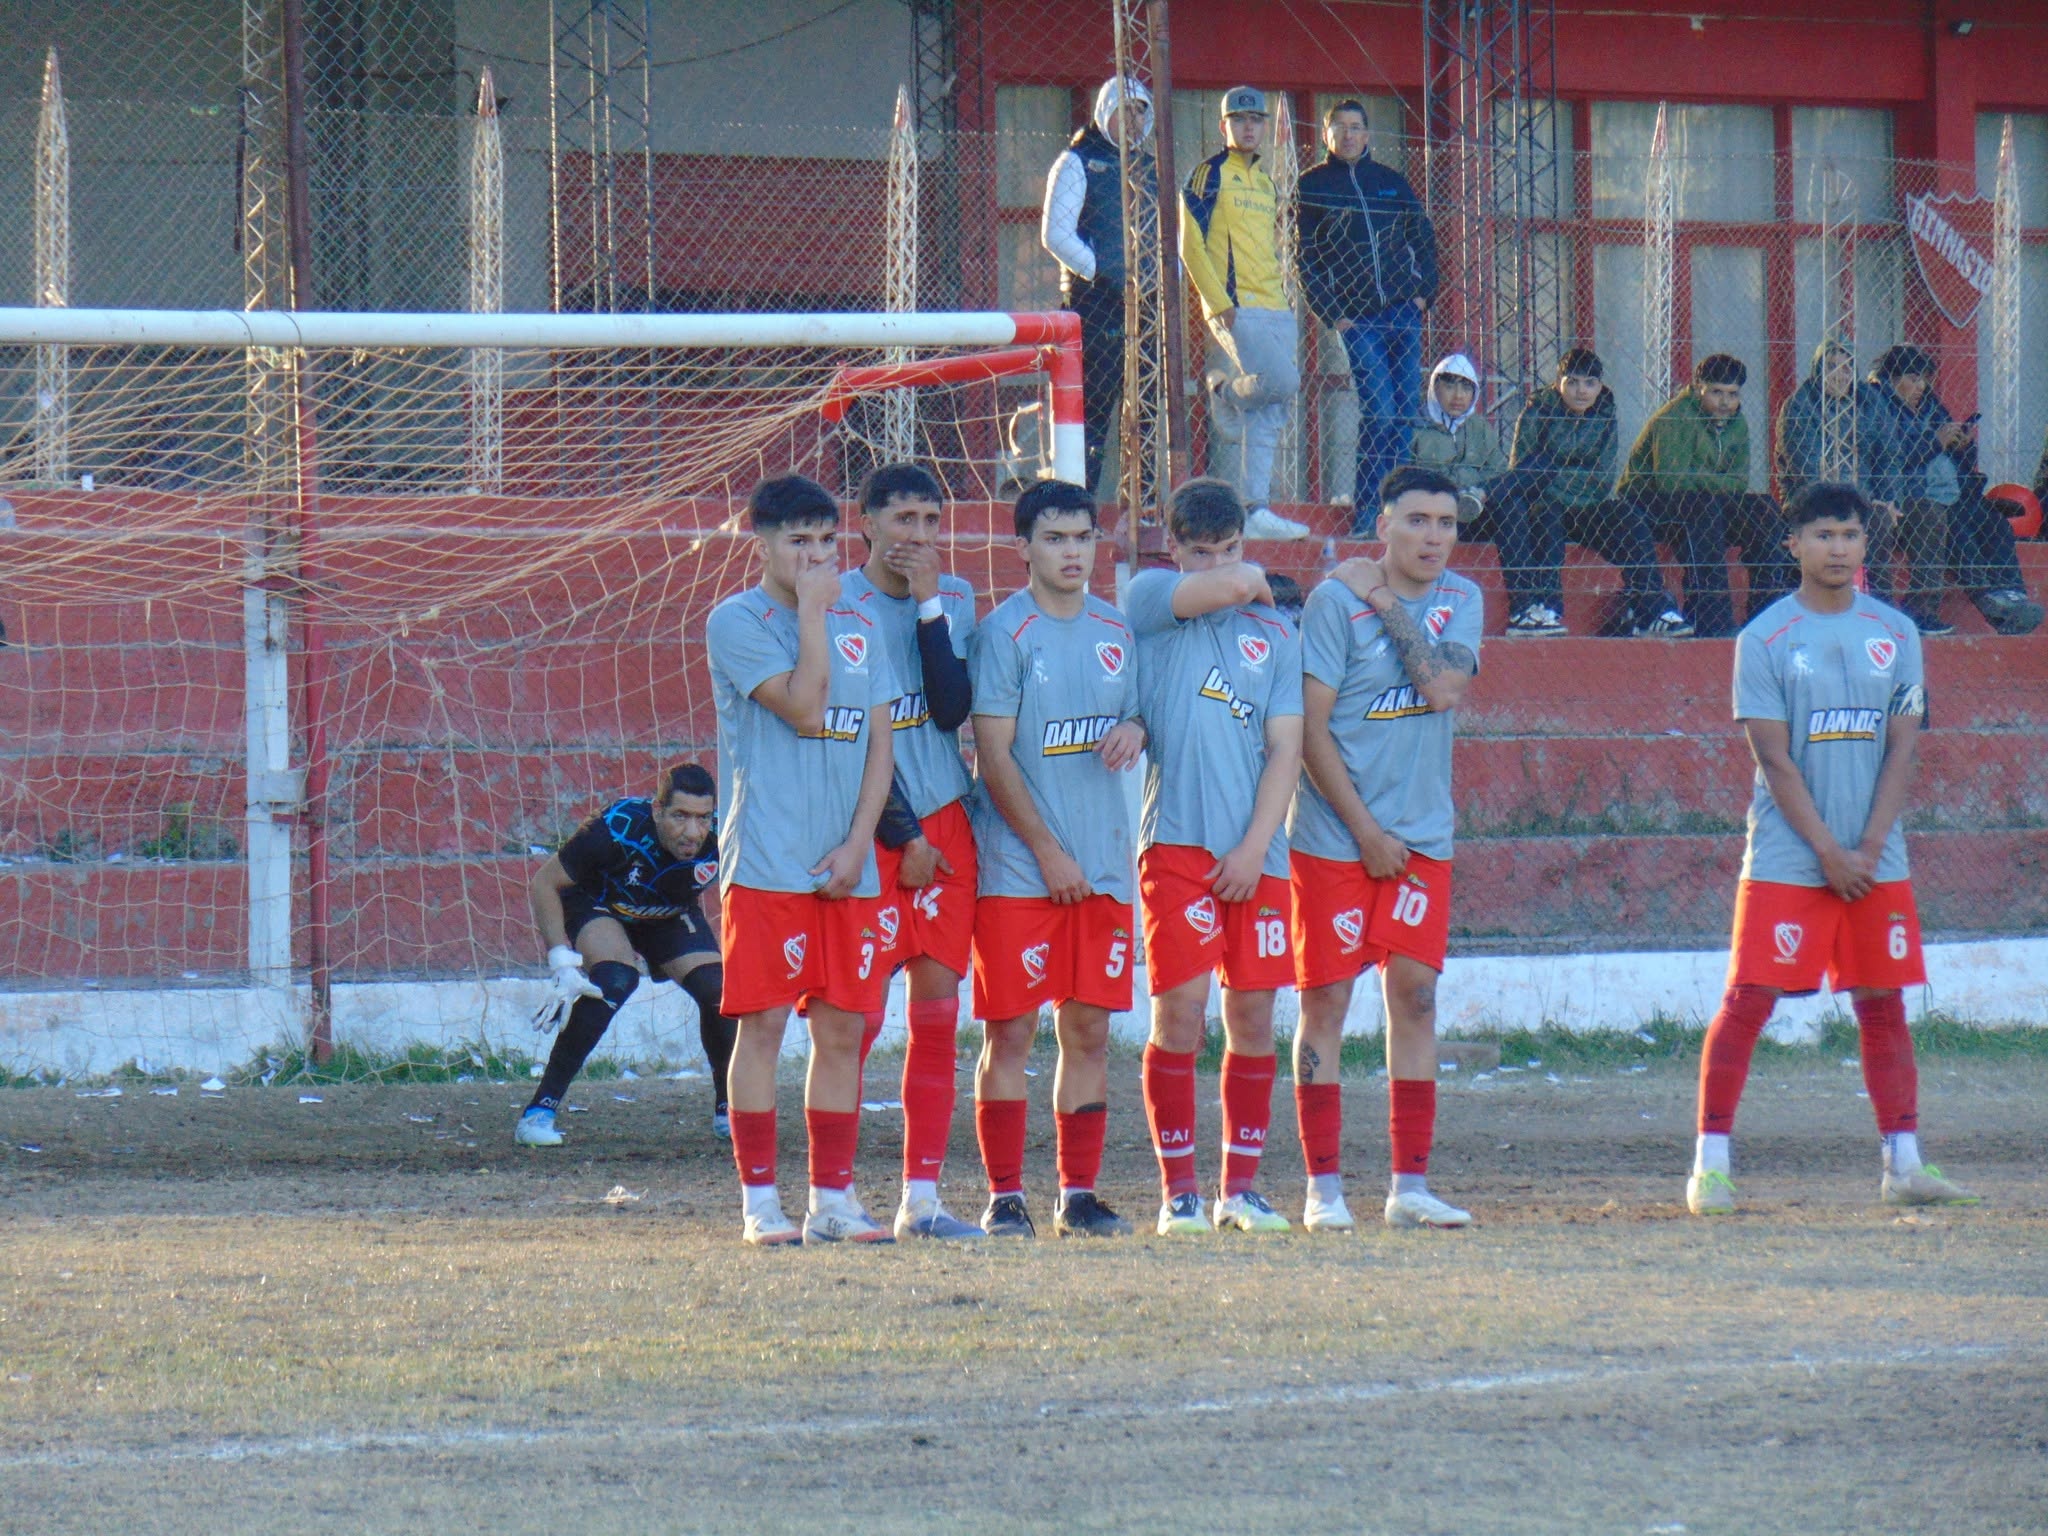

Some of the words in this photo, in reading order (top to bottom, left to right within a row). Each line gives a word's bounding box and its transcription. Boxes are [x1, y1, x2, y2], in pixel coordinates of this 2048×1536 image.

[679, 912, 697, 934] 1
[1391, 884, 1429, 927] 10
[1254, 919, 1286, 958] 18
[1888, 925, 1908, 961] 6
[858, 942, 875, 980] 3
[1105, 941, 1128, 979] 5
[1161, 1129, 1189, 1144] CAI
[1239, 1127, 1266, 1142] CAI
